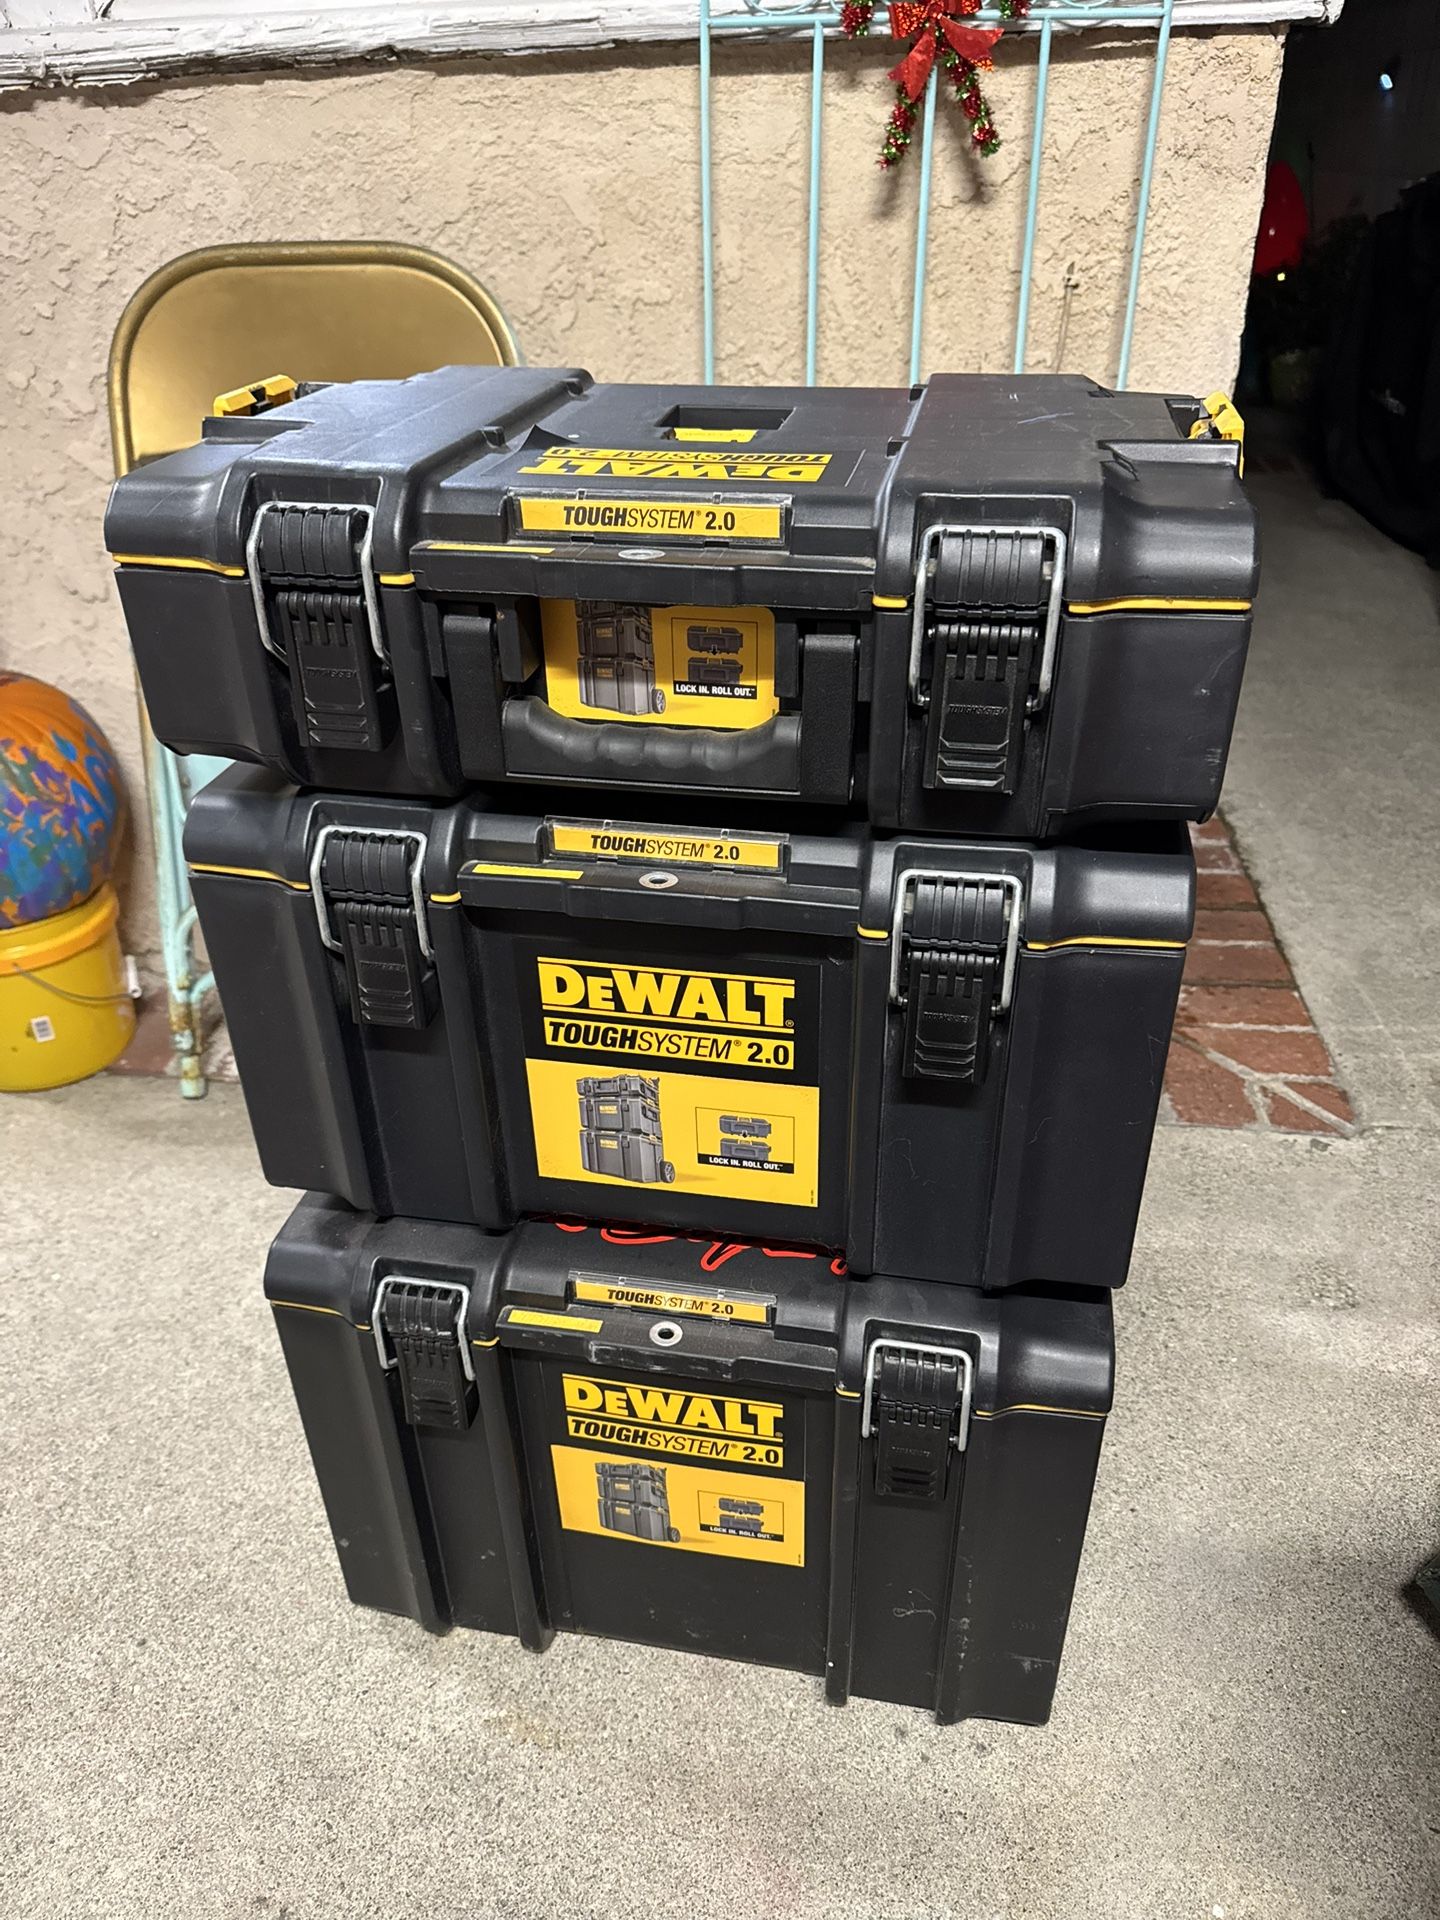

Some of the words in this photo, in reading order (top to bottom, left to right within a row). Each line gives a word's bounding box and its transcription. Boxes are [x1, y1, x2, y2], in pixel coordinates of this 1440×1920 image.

[551, 448, 598, 457] 2.0
[518, 460, 825, 481] DEWALT
[705, 511, 736, 531] 2.0
[675, 684, 697, 693] LOCK
[698, 685, 710, 694] IN.
[711, 686, 732, 695] ROLL
[714, 845, 740, 860] 2.0
[748, 1042, 790, 1065] 2.0
[709, 1156, 729, 1165] LOCK
[730, 1159, 741, 1167] IN.
[742, 1160, 762, 1168] ROLL
[711, 1302, 734, 1315] 2.0
[742, 1446, 780, 1464] 2.0
